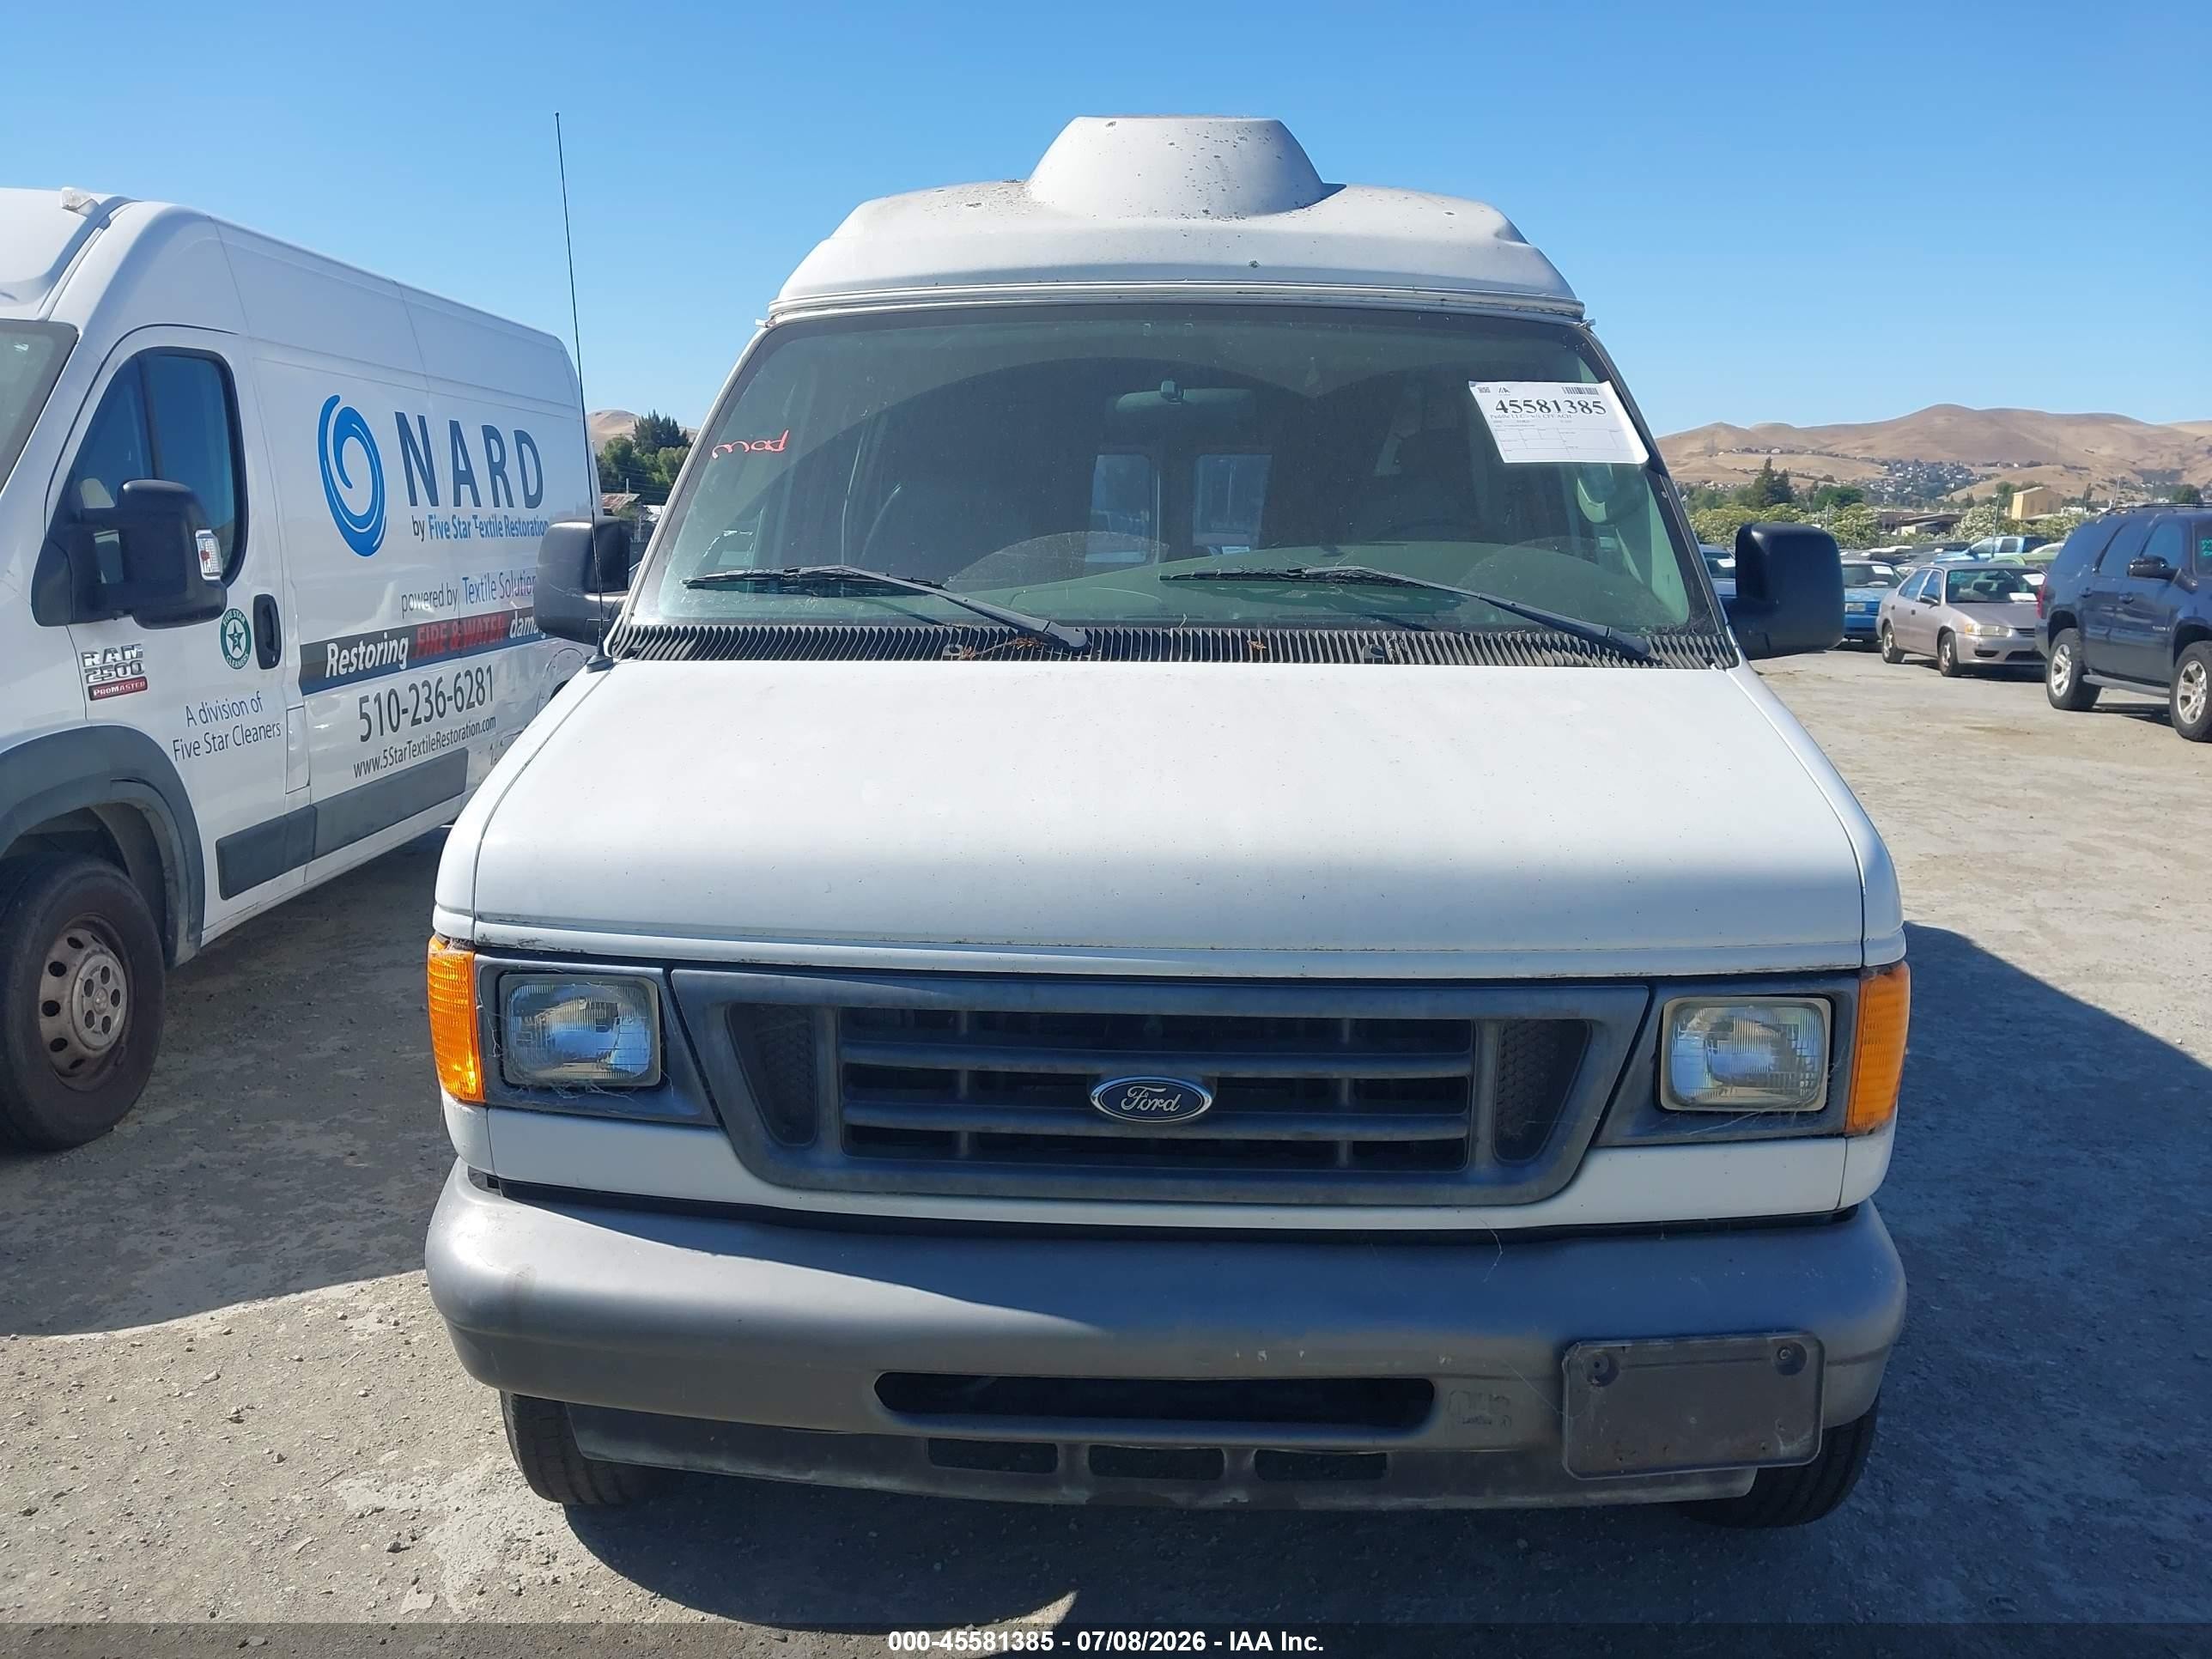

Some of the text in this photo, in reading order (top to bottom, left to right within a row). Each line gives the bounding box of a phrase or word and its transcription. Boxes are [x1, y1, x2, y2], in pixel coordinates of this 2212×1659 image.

[1495, 398, 1607, 415] 45581385
[394, 411, 544, 508] NARD
[411, 514, 550, 542] by Five Star Textile Restoration
[401, 582, 444, 619] powered
[447, 582, 458, 611] by
[462, 573, 496, 605] Textile
[223, 610, 246, 626] FIVE STAR
[234, 633, 239, 646] 5
[325, 632, 409, 678] Restoring
[416, 623, 447, 659] FIRE
[450, 620, 462, 652] &
[82, 644, 143, 667] RAM
[227, 652, 248, 668] CLEANERS
[84, 660, 144, 684] 2500
[185, 690, 263, 727] A division of
[358, 665, 494, 743] 510-236-6281
[172, 723, 281, 762] Five Star Cleaners
[354, 716, 496, 778] www.5StarTextileRestoration.com
[1121, 1085, 1182, 1112] Ford
